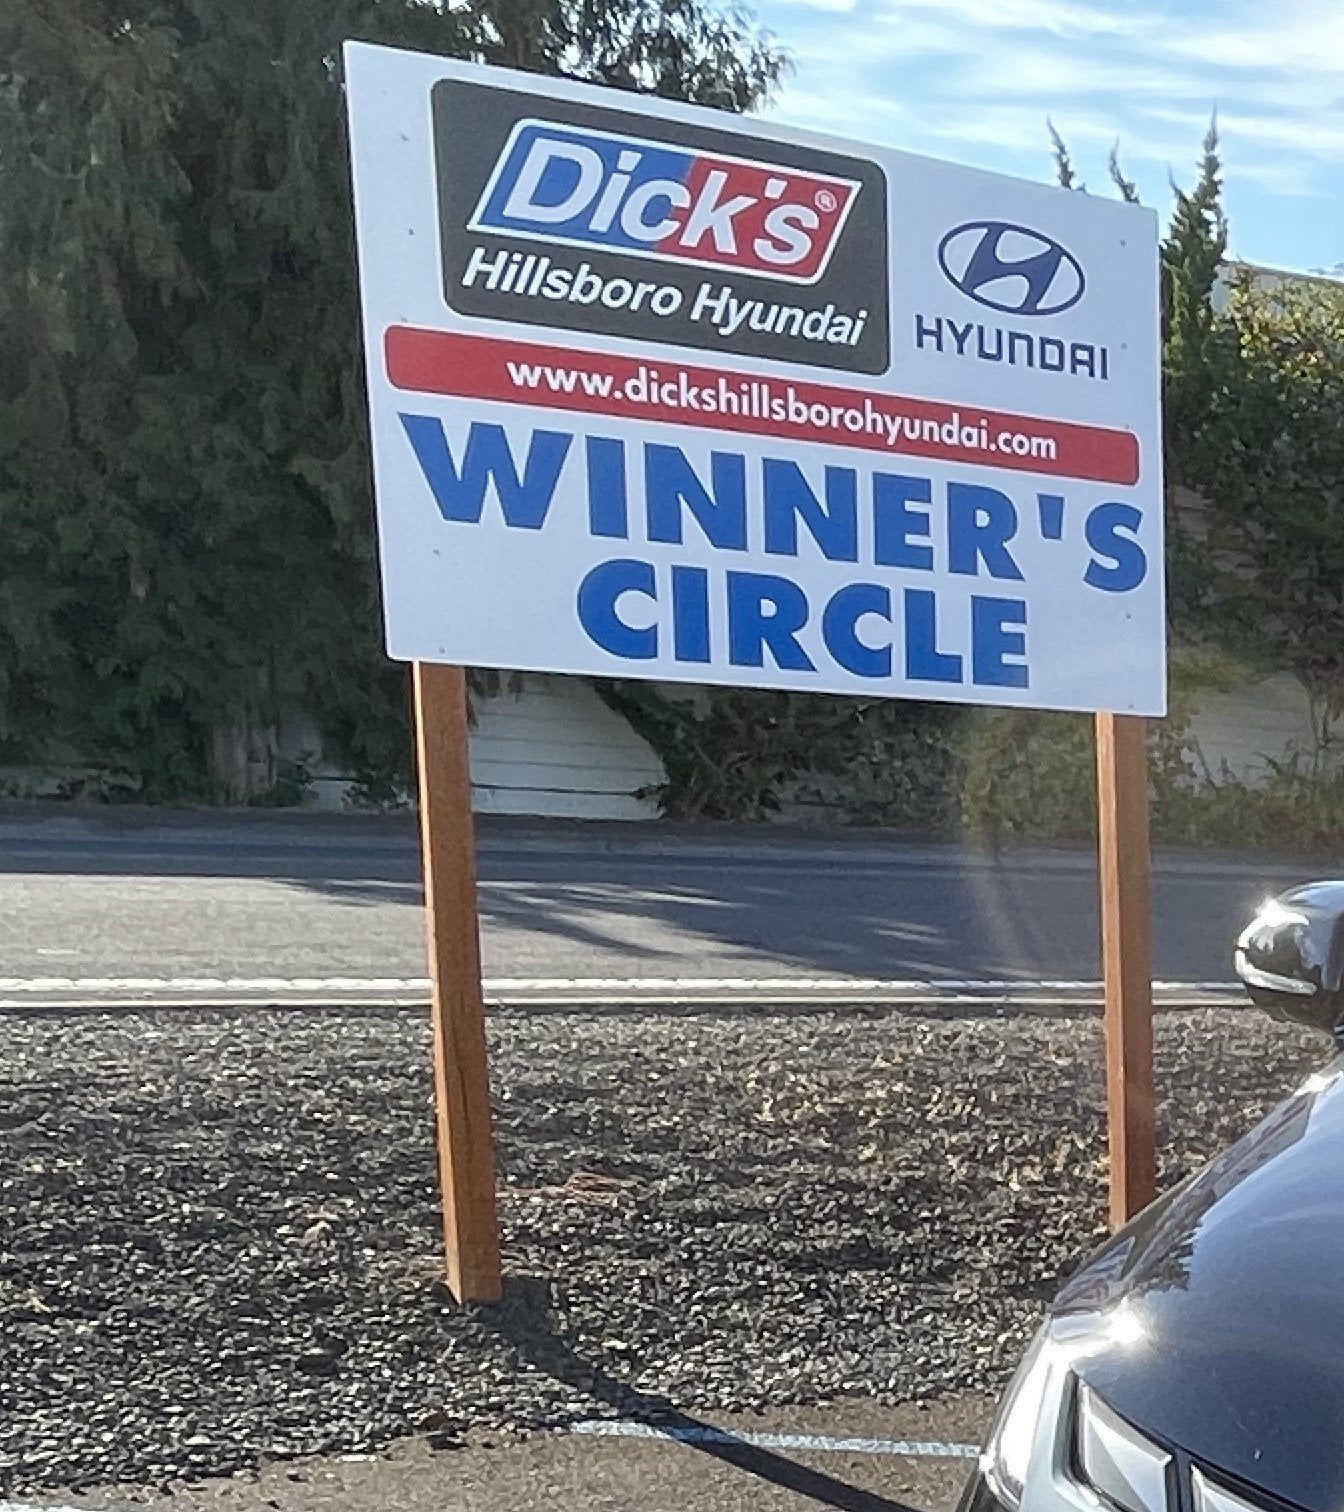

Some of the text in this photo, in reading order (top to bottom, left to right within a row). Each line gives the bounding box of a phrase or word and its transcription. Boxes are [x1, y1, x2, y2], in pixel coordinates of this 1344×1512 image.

[503, 138, 820, 265] Dick's
[462, 247, 868, 347] Hillsboro Hyundai
[915, 314, 1109, 380] HYUNDAI
[506, 362, 1058, 461] www.dickshillsborohyundai.com
[399, 413, 1150, 593] WINNER'S
[577, 558, 1030, 690] CIRCLE
